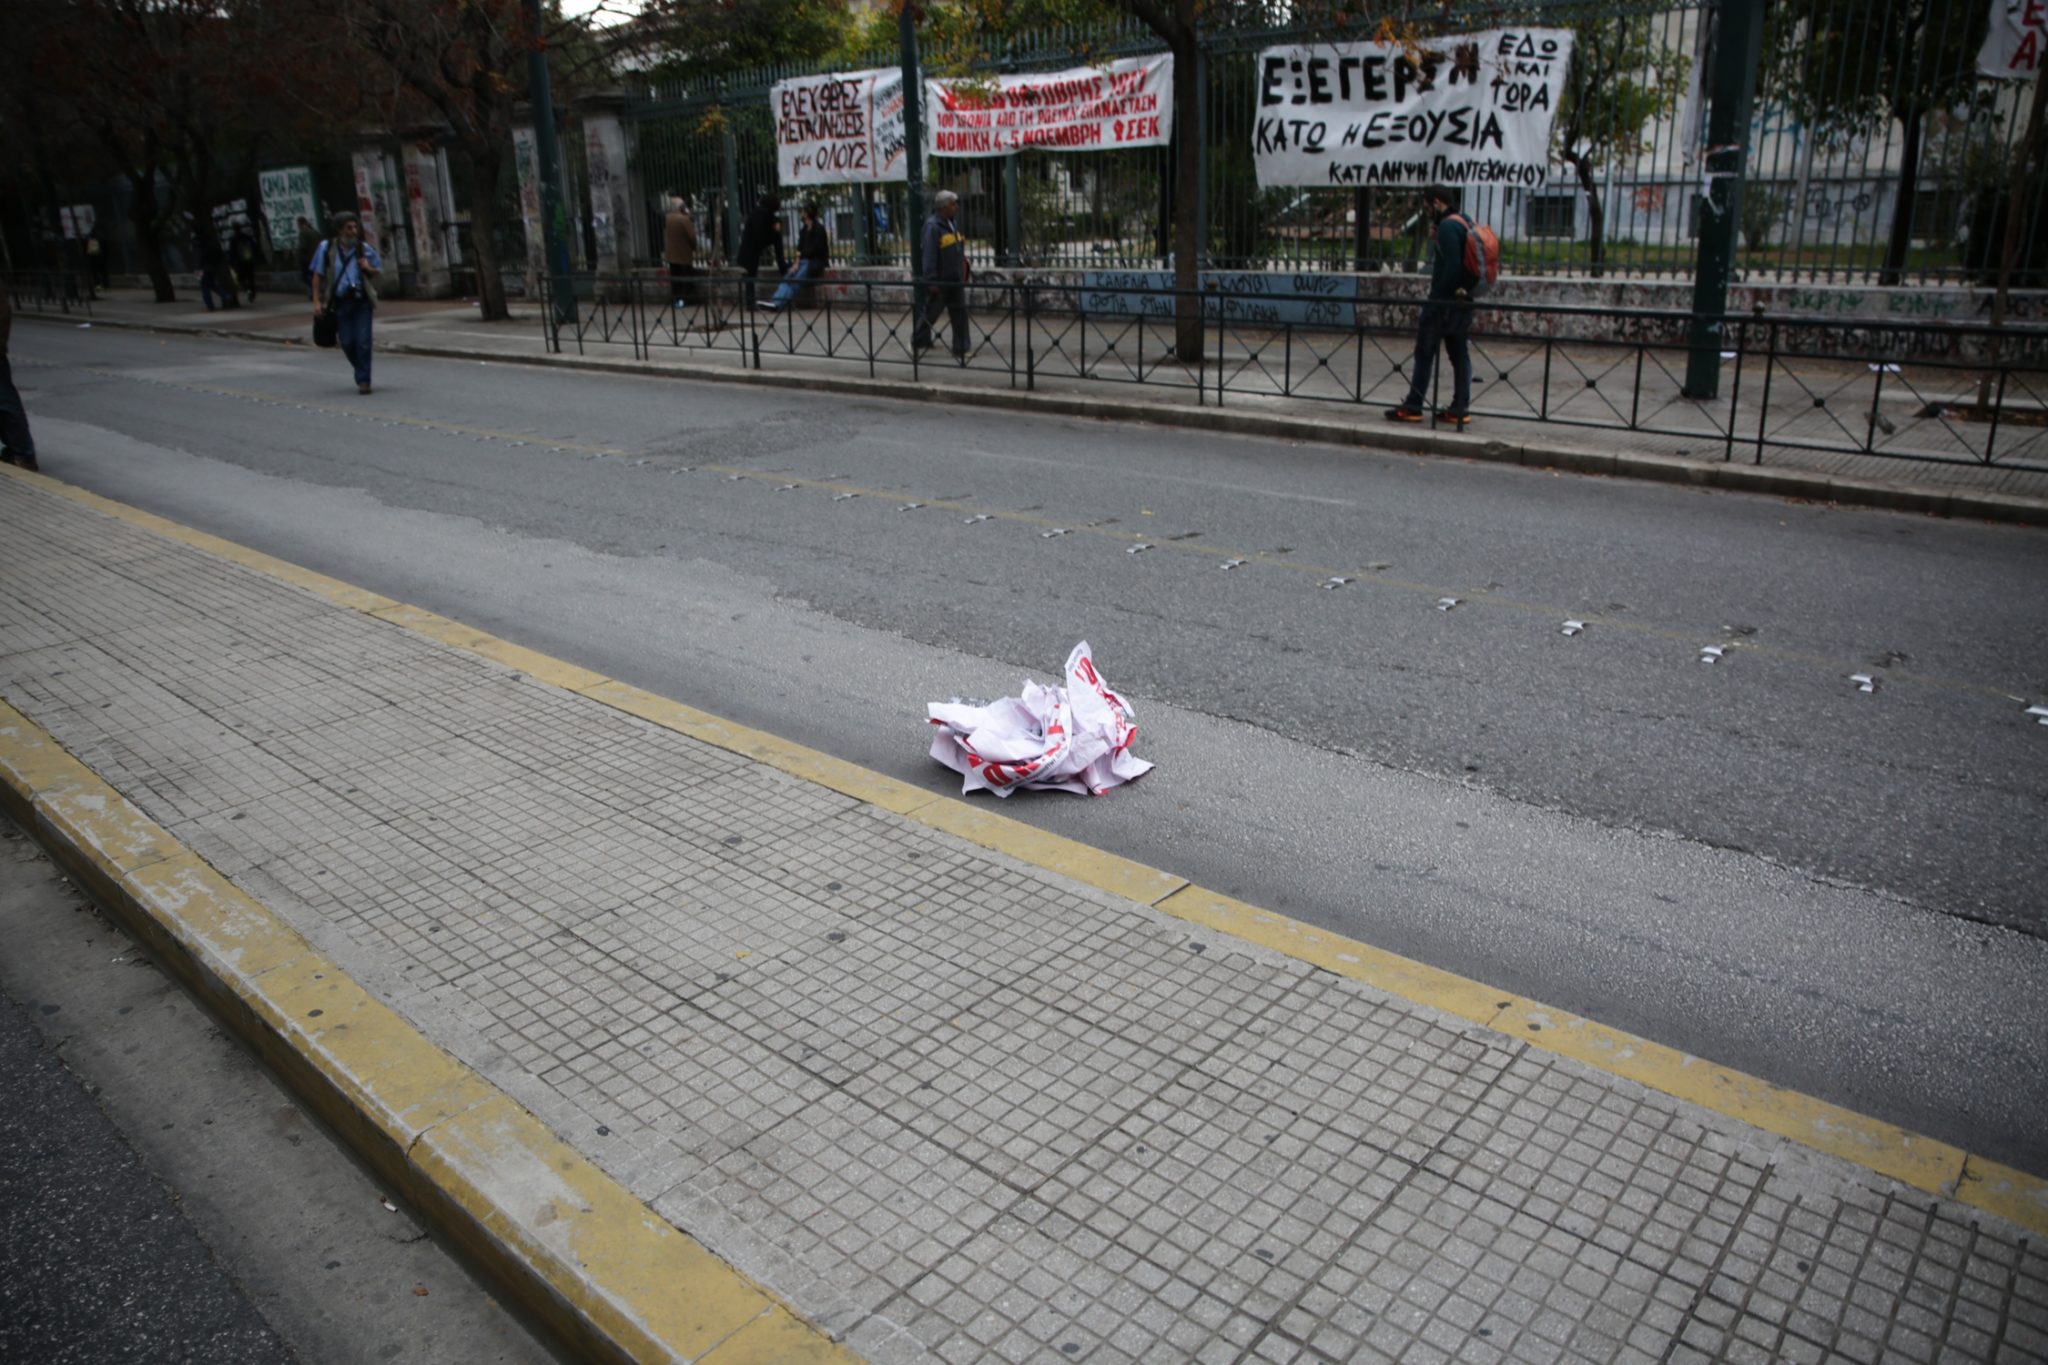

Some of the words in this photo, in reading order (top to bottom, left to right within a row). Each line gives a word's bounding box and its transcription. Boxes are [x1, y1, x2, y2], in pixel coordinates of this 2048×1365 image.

[1498, 33, 1557, 60] ΕΔΩ
[1515, 61, 1549, 76] ΚΑΙ
[937, 131, 990, 152] ΝΟΜΙΚΗ
[1023, 121, 1101, 148] ΝΟΕΜΒΡΗ
[1362, 105, 1503, 150] ΕΞΟΥΣΙΑ
[816, 142, 868, 170] ΟΛΟΥΣ
[1329, 160, 1428, 184] ΚΑΤΑΛΗΨΗ
[1431, 154, 1546, 187] ΠΟΛΥΤΕΧΝΕΙΟΥ
